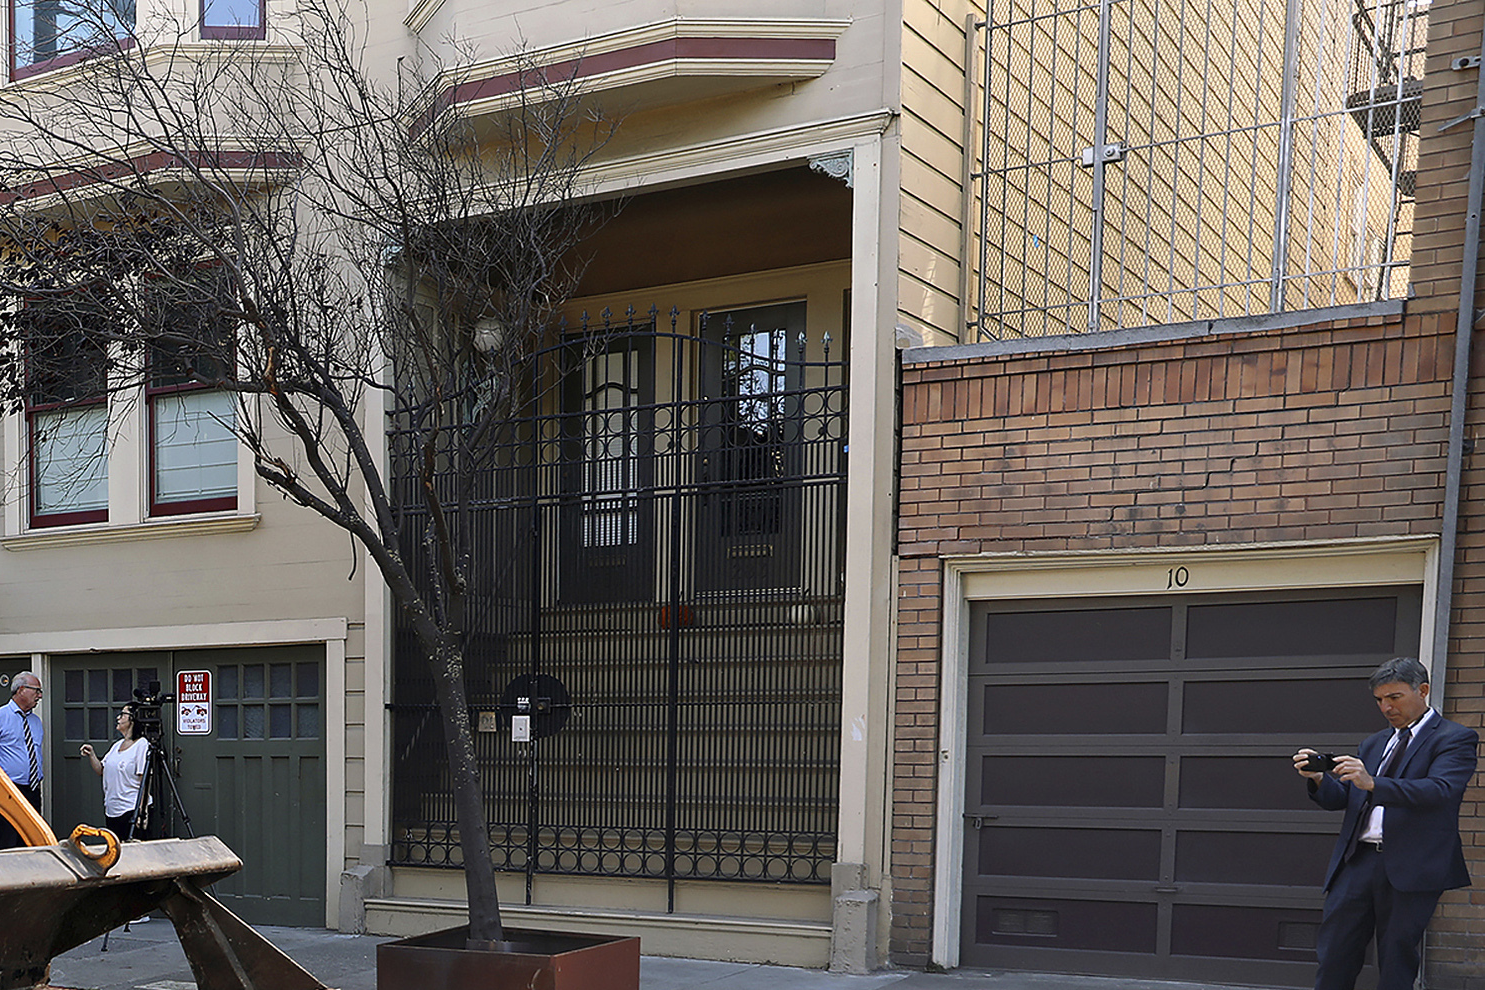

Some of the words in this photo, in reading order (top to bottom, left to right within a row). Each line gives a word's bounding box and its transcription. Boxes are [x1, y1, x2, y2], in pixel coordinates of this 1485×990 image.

[1166, 566, 1189, 590] 10
[184, 674, 192, 682] DO
[193, 674, 204, 682] NOT
[186, 684, 202, 692] BLOCK
[181, 693, 207, 701] DRIVEWAY
